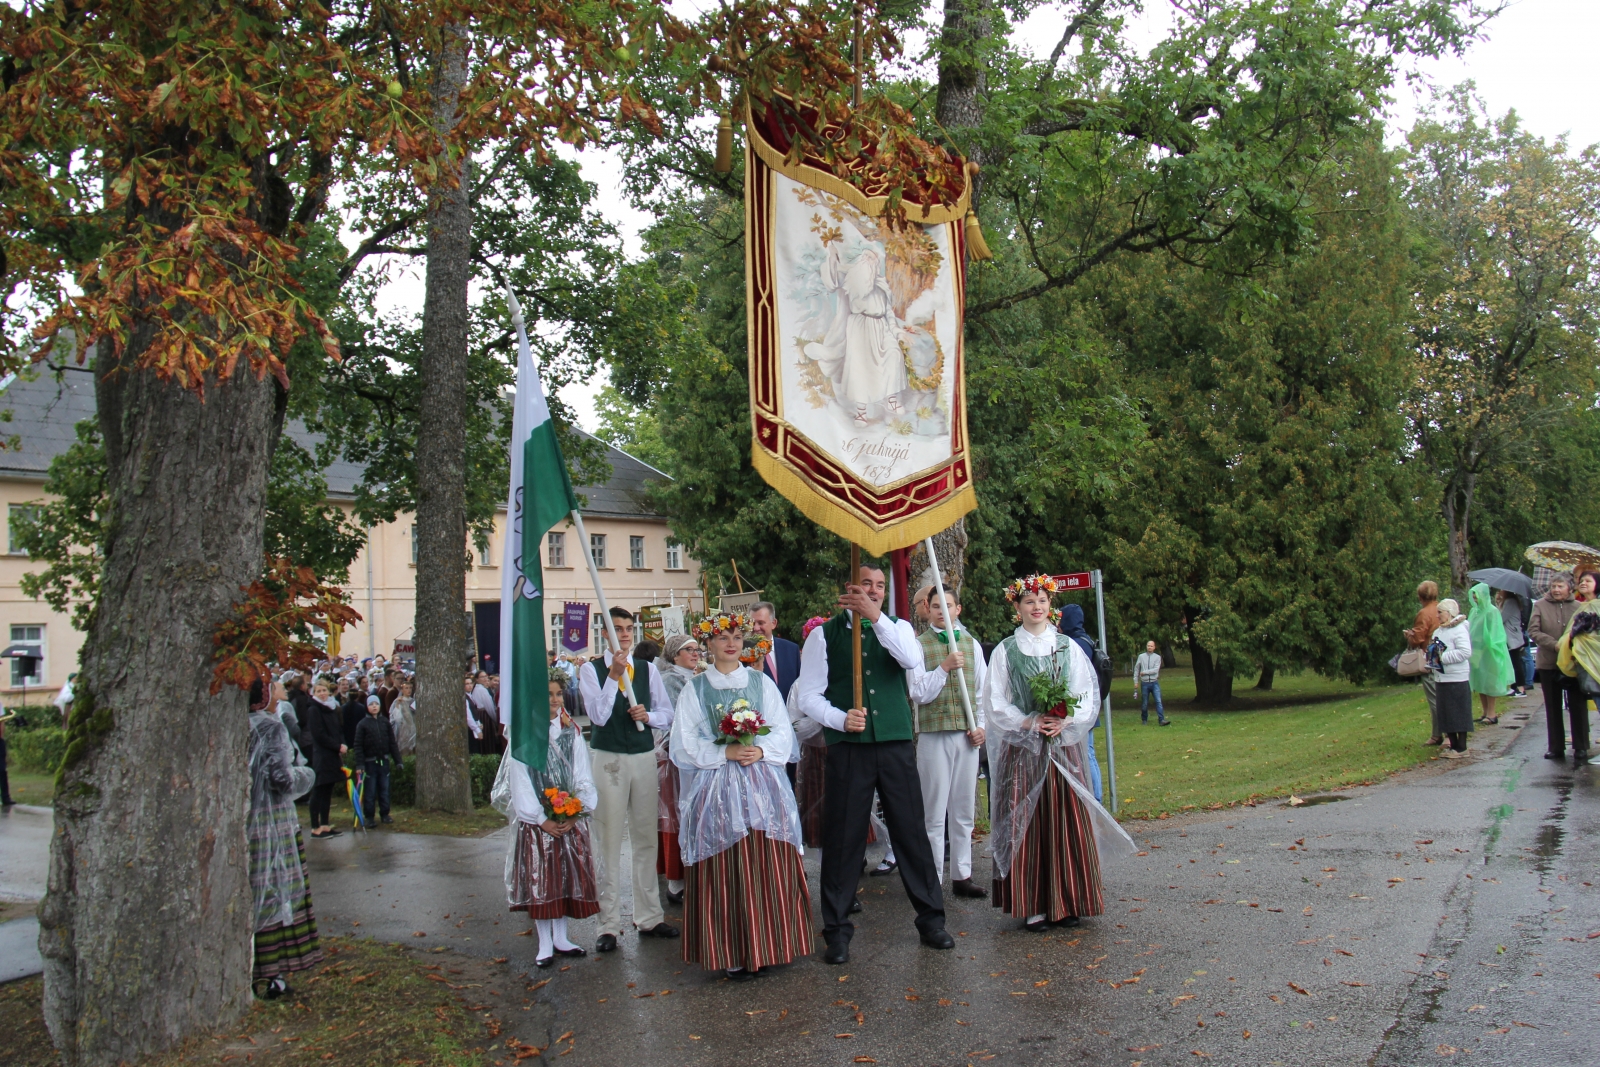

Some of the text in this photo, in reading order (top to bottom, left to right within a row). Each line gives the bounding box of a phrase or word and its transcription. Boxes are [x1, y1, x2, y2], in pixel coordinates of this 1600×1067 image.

[842, 437, 858, 452] 26
[862, 464, 892, 486] 1873
[1067, 577, 1079, 586] iela
[644, 620, 662, 628] FORTI
